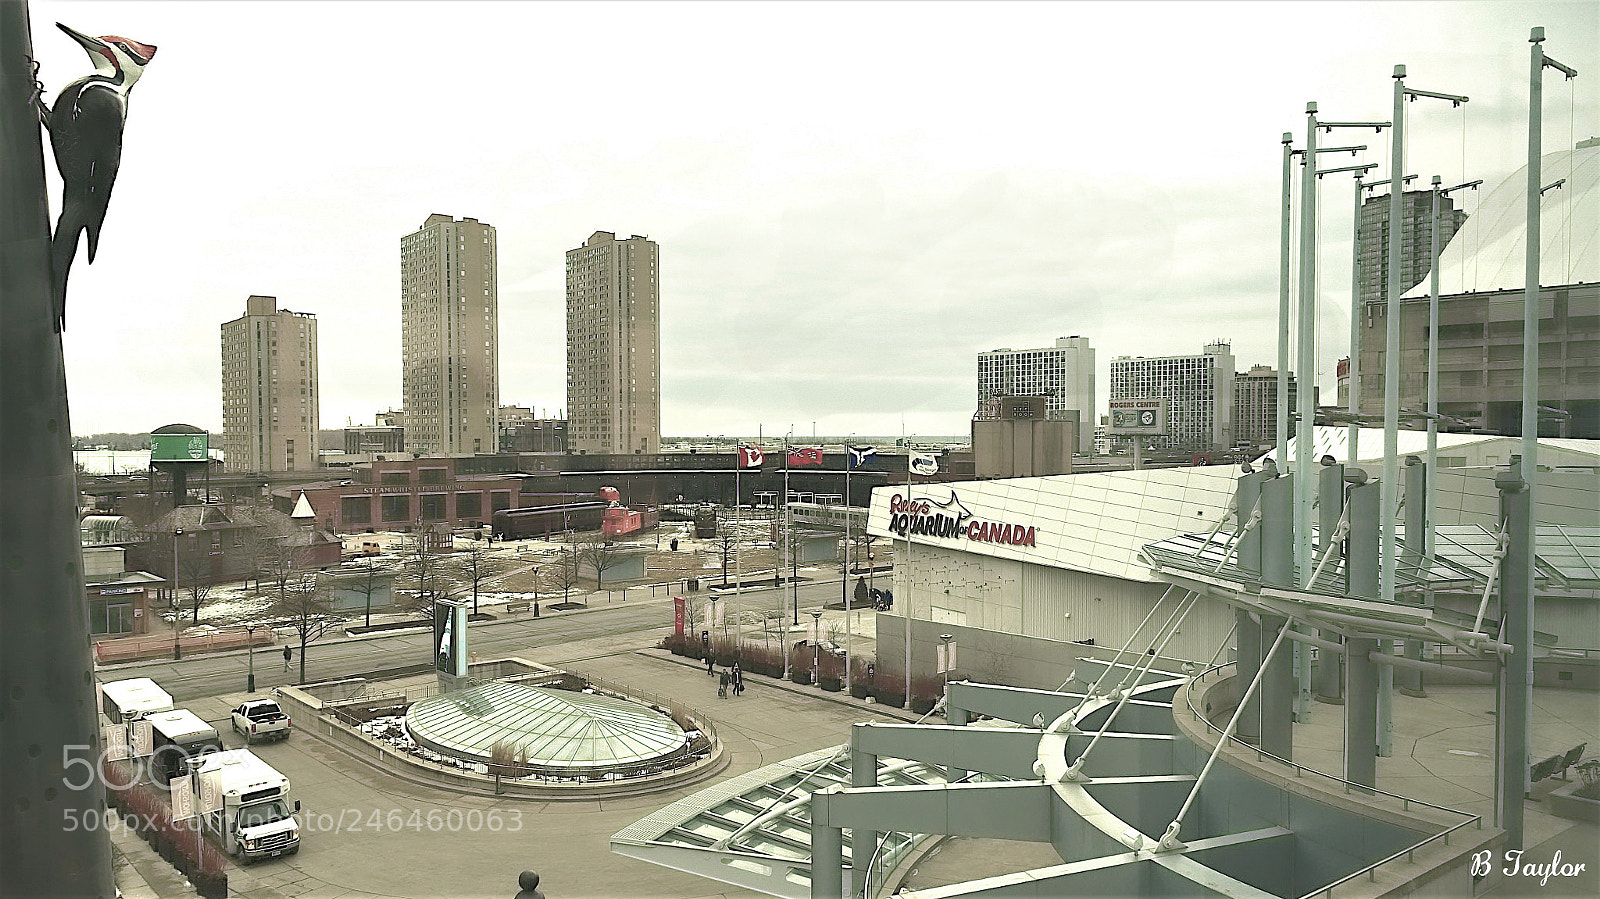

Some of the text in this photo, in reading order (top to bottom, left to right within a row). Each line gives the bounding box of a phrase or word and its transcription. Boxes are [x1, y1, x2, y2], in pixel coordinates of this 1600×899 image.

[888, 511, 1036, 548] AQUARIUM OF CANADA
